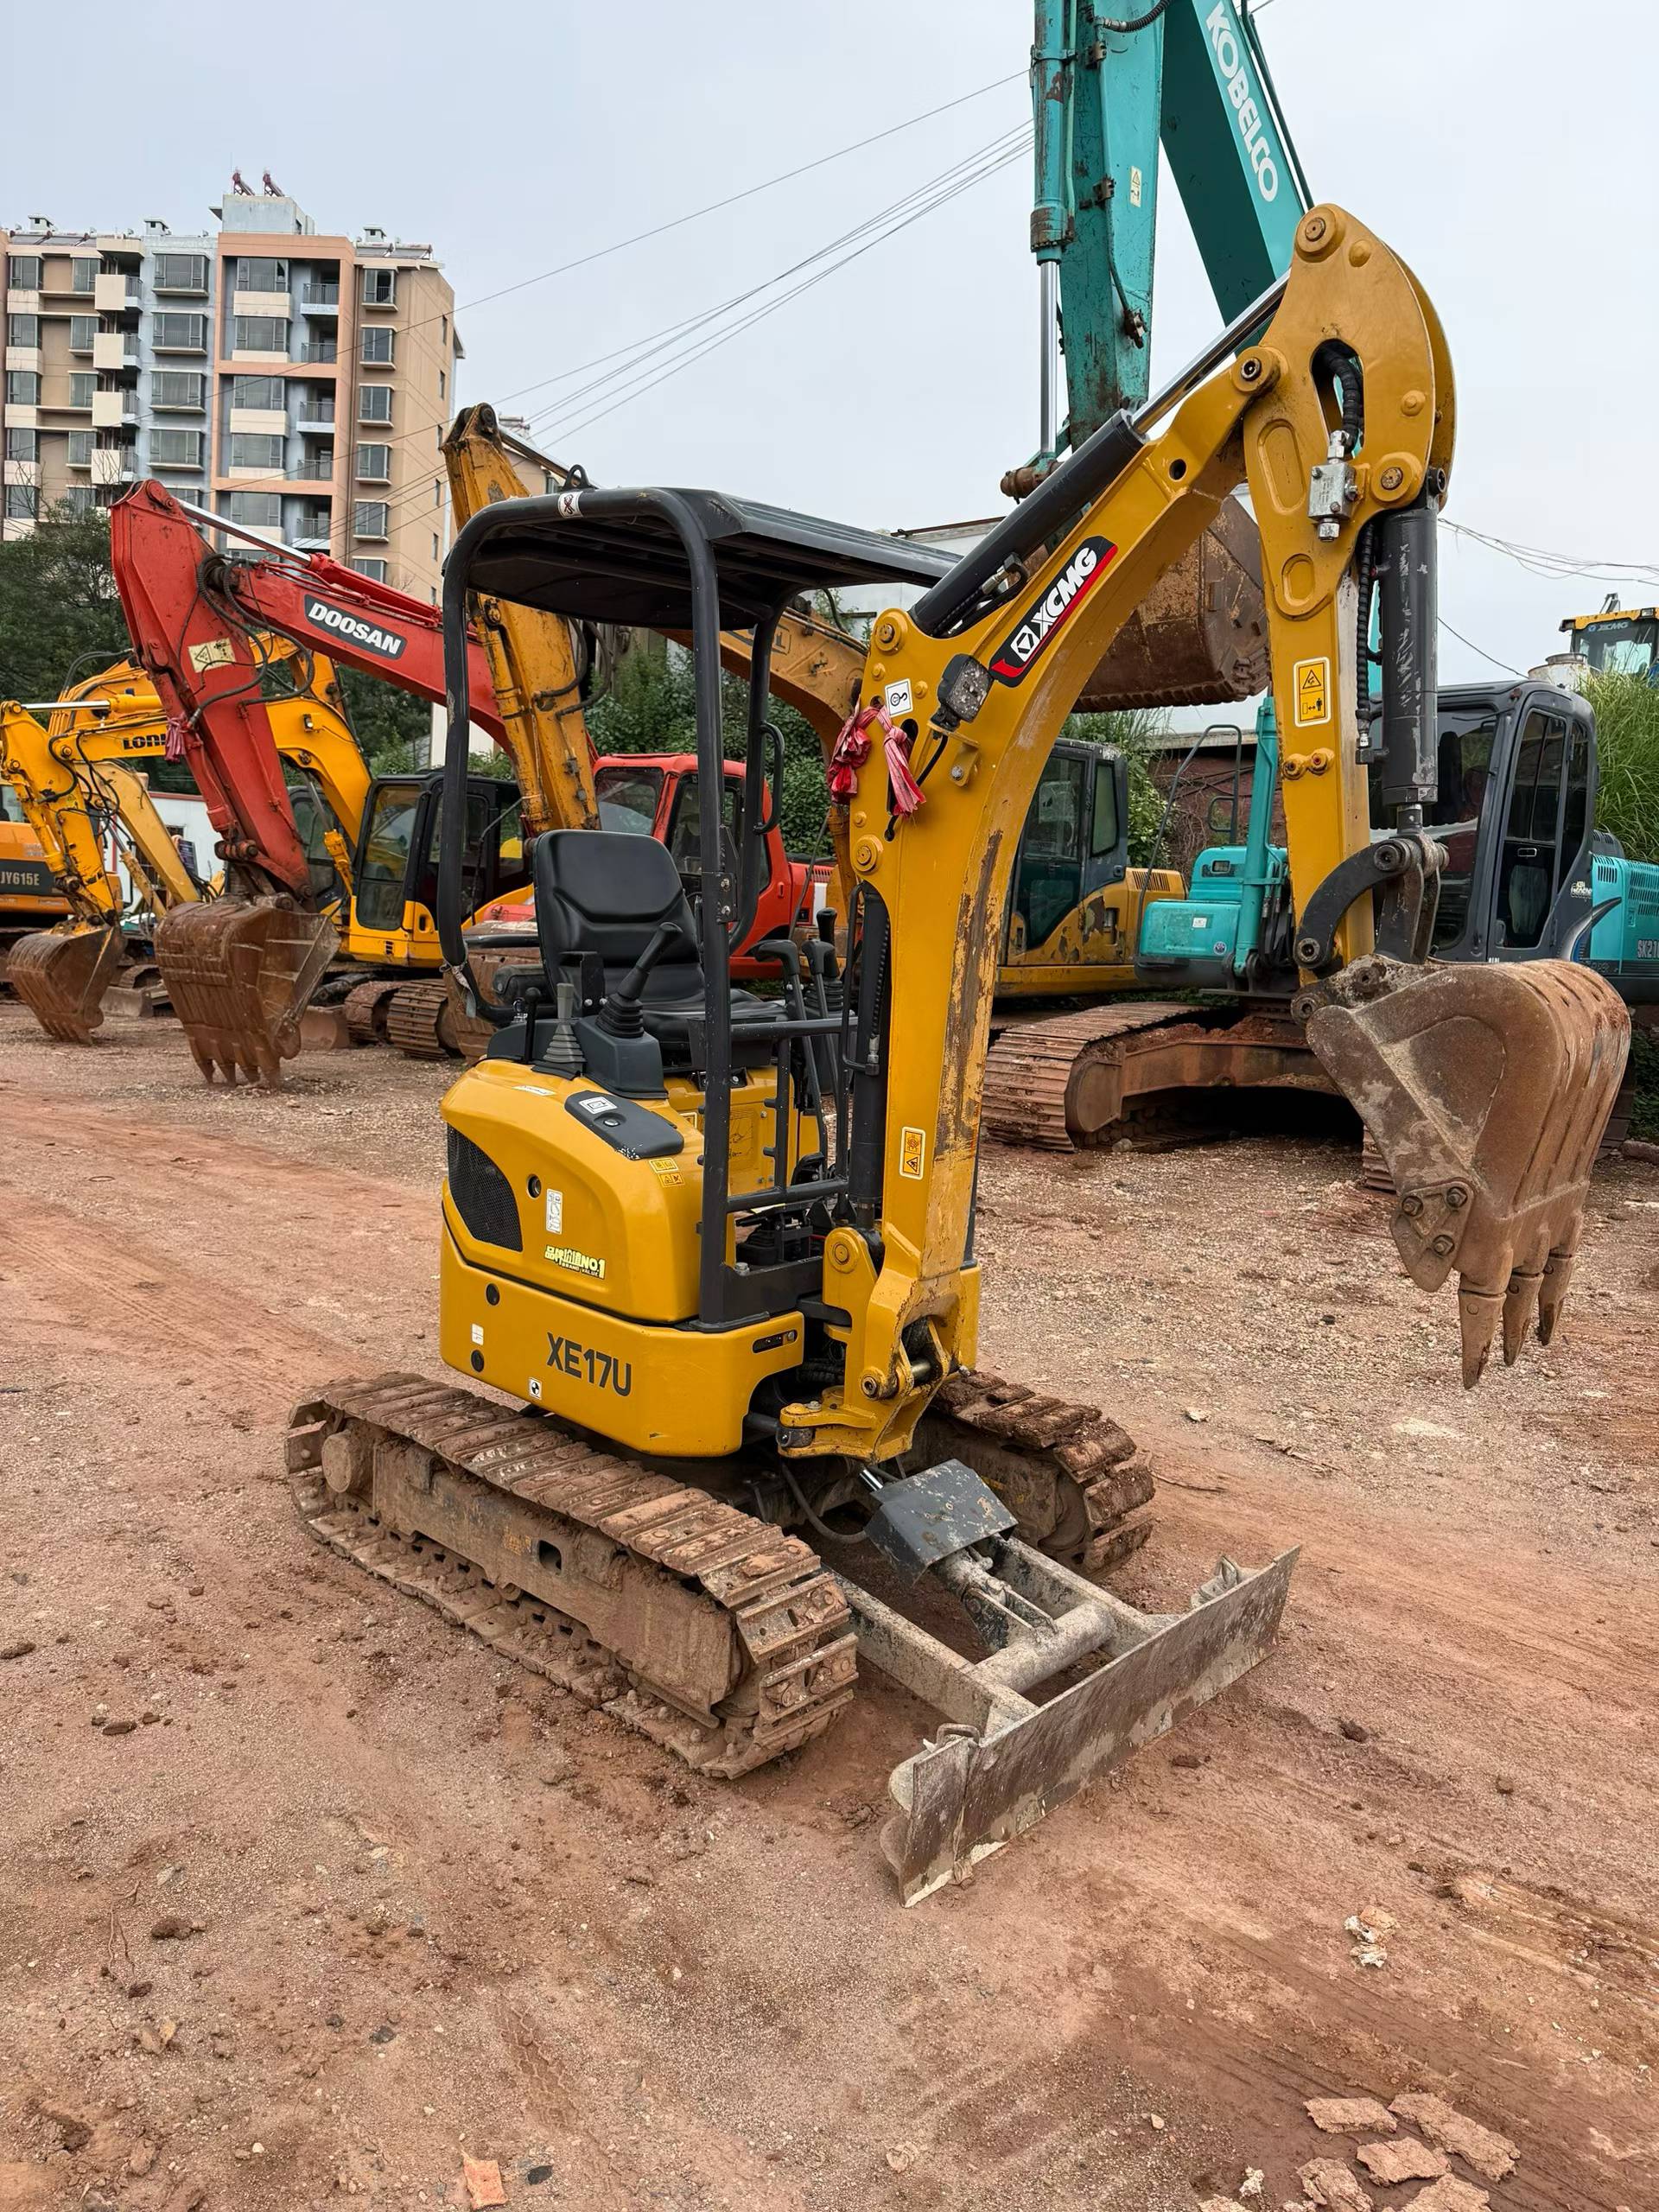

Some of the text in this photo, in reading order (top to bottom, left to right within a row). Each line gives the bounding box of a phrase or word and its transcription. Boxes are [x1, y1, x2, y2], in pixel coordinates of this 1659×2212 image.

[1206, 2, 1278, 202] KOBELCO
[1031, 547, 1097, 639] XCMG
[308, 602, 401, 655] DOOSAN
[1, 870, 40, 887] JY615E
[1637, 939, 1659, 959] SK21
[546, 1332, 632, 1397] XE17U
